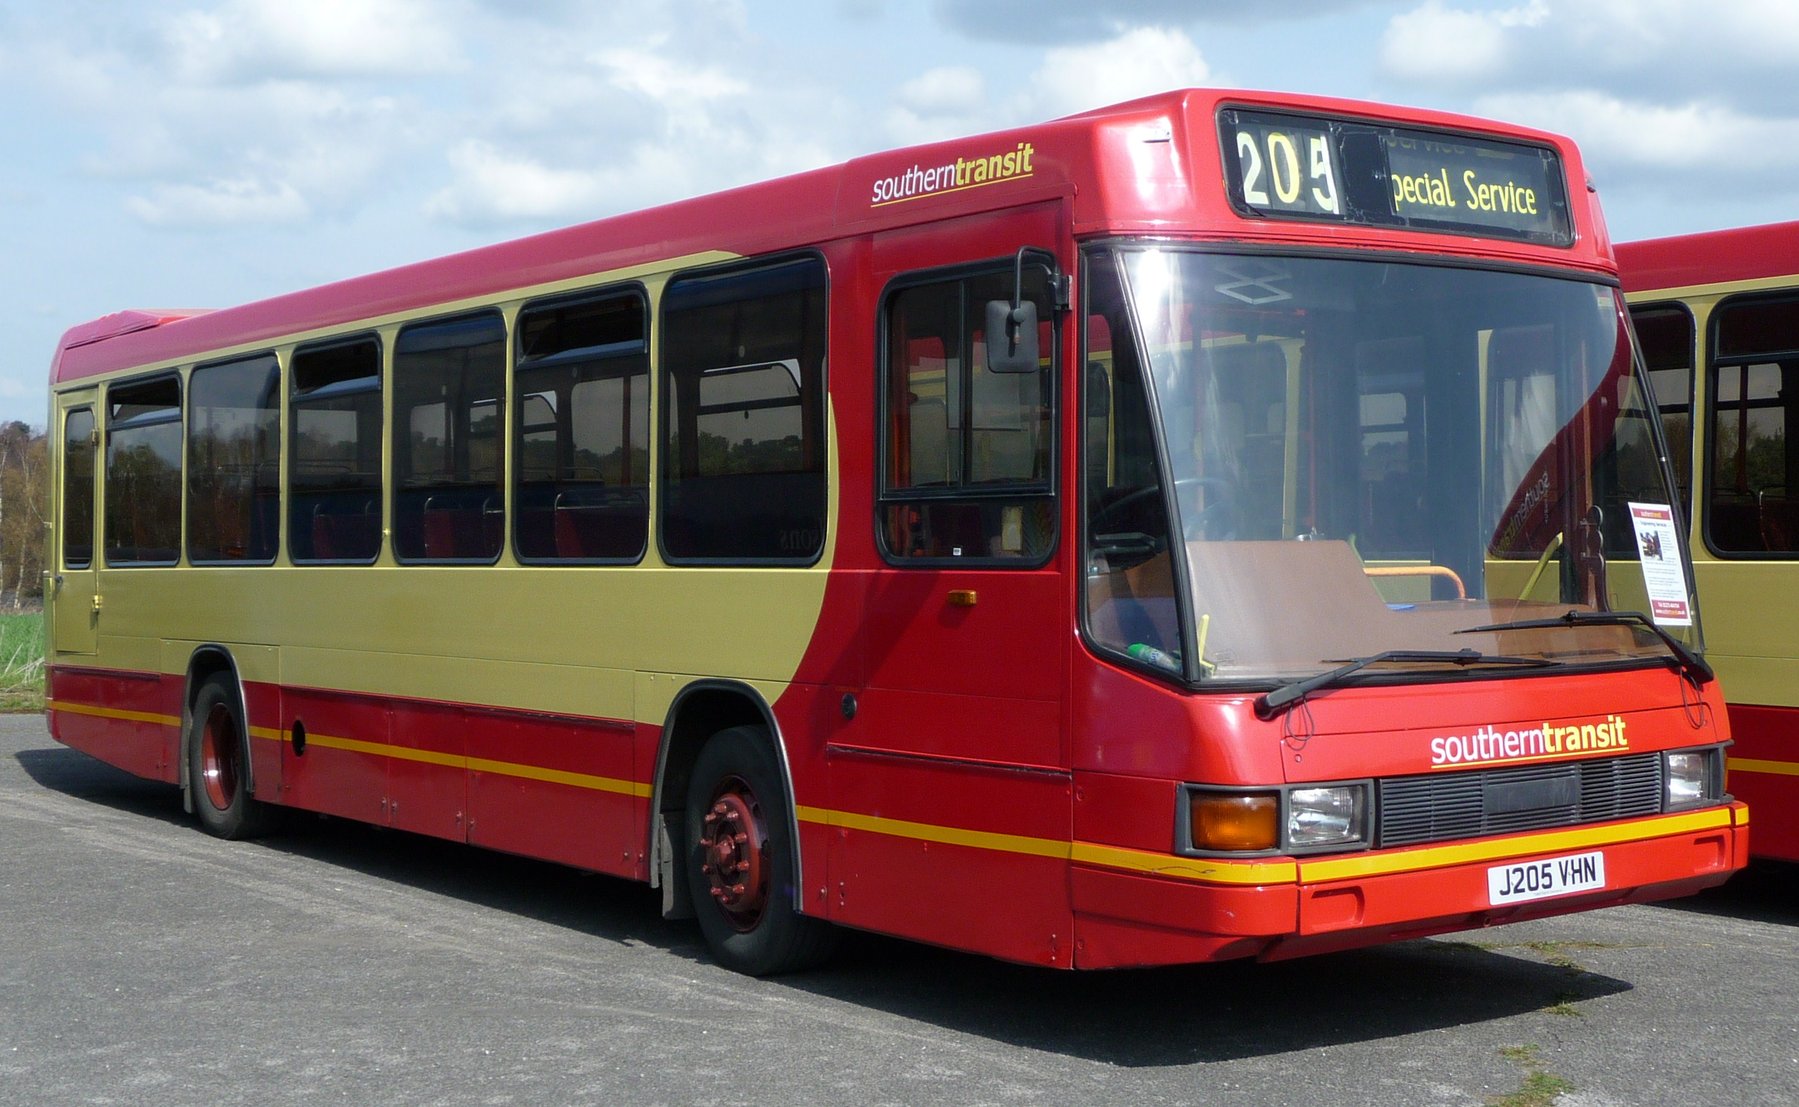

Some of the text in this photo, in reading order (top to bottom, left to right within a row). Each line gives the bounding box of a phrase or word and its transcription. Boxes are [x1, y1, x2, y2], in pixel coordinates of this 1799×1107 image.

[871, 142, 1034, 203] southerntransit
[1236, 131, 1339, 215] 205
[1390, 168, 1537, 215] pecial Service
[1430, 714, 1628, 764] southerntransit
[1499, 856, 1596, 896] J205 VHN
